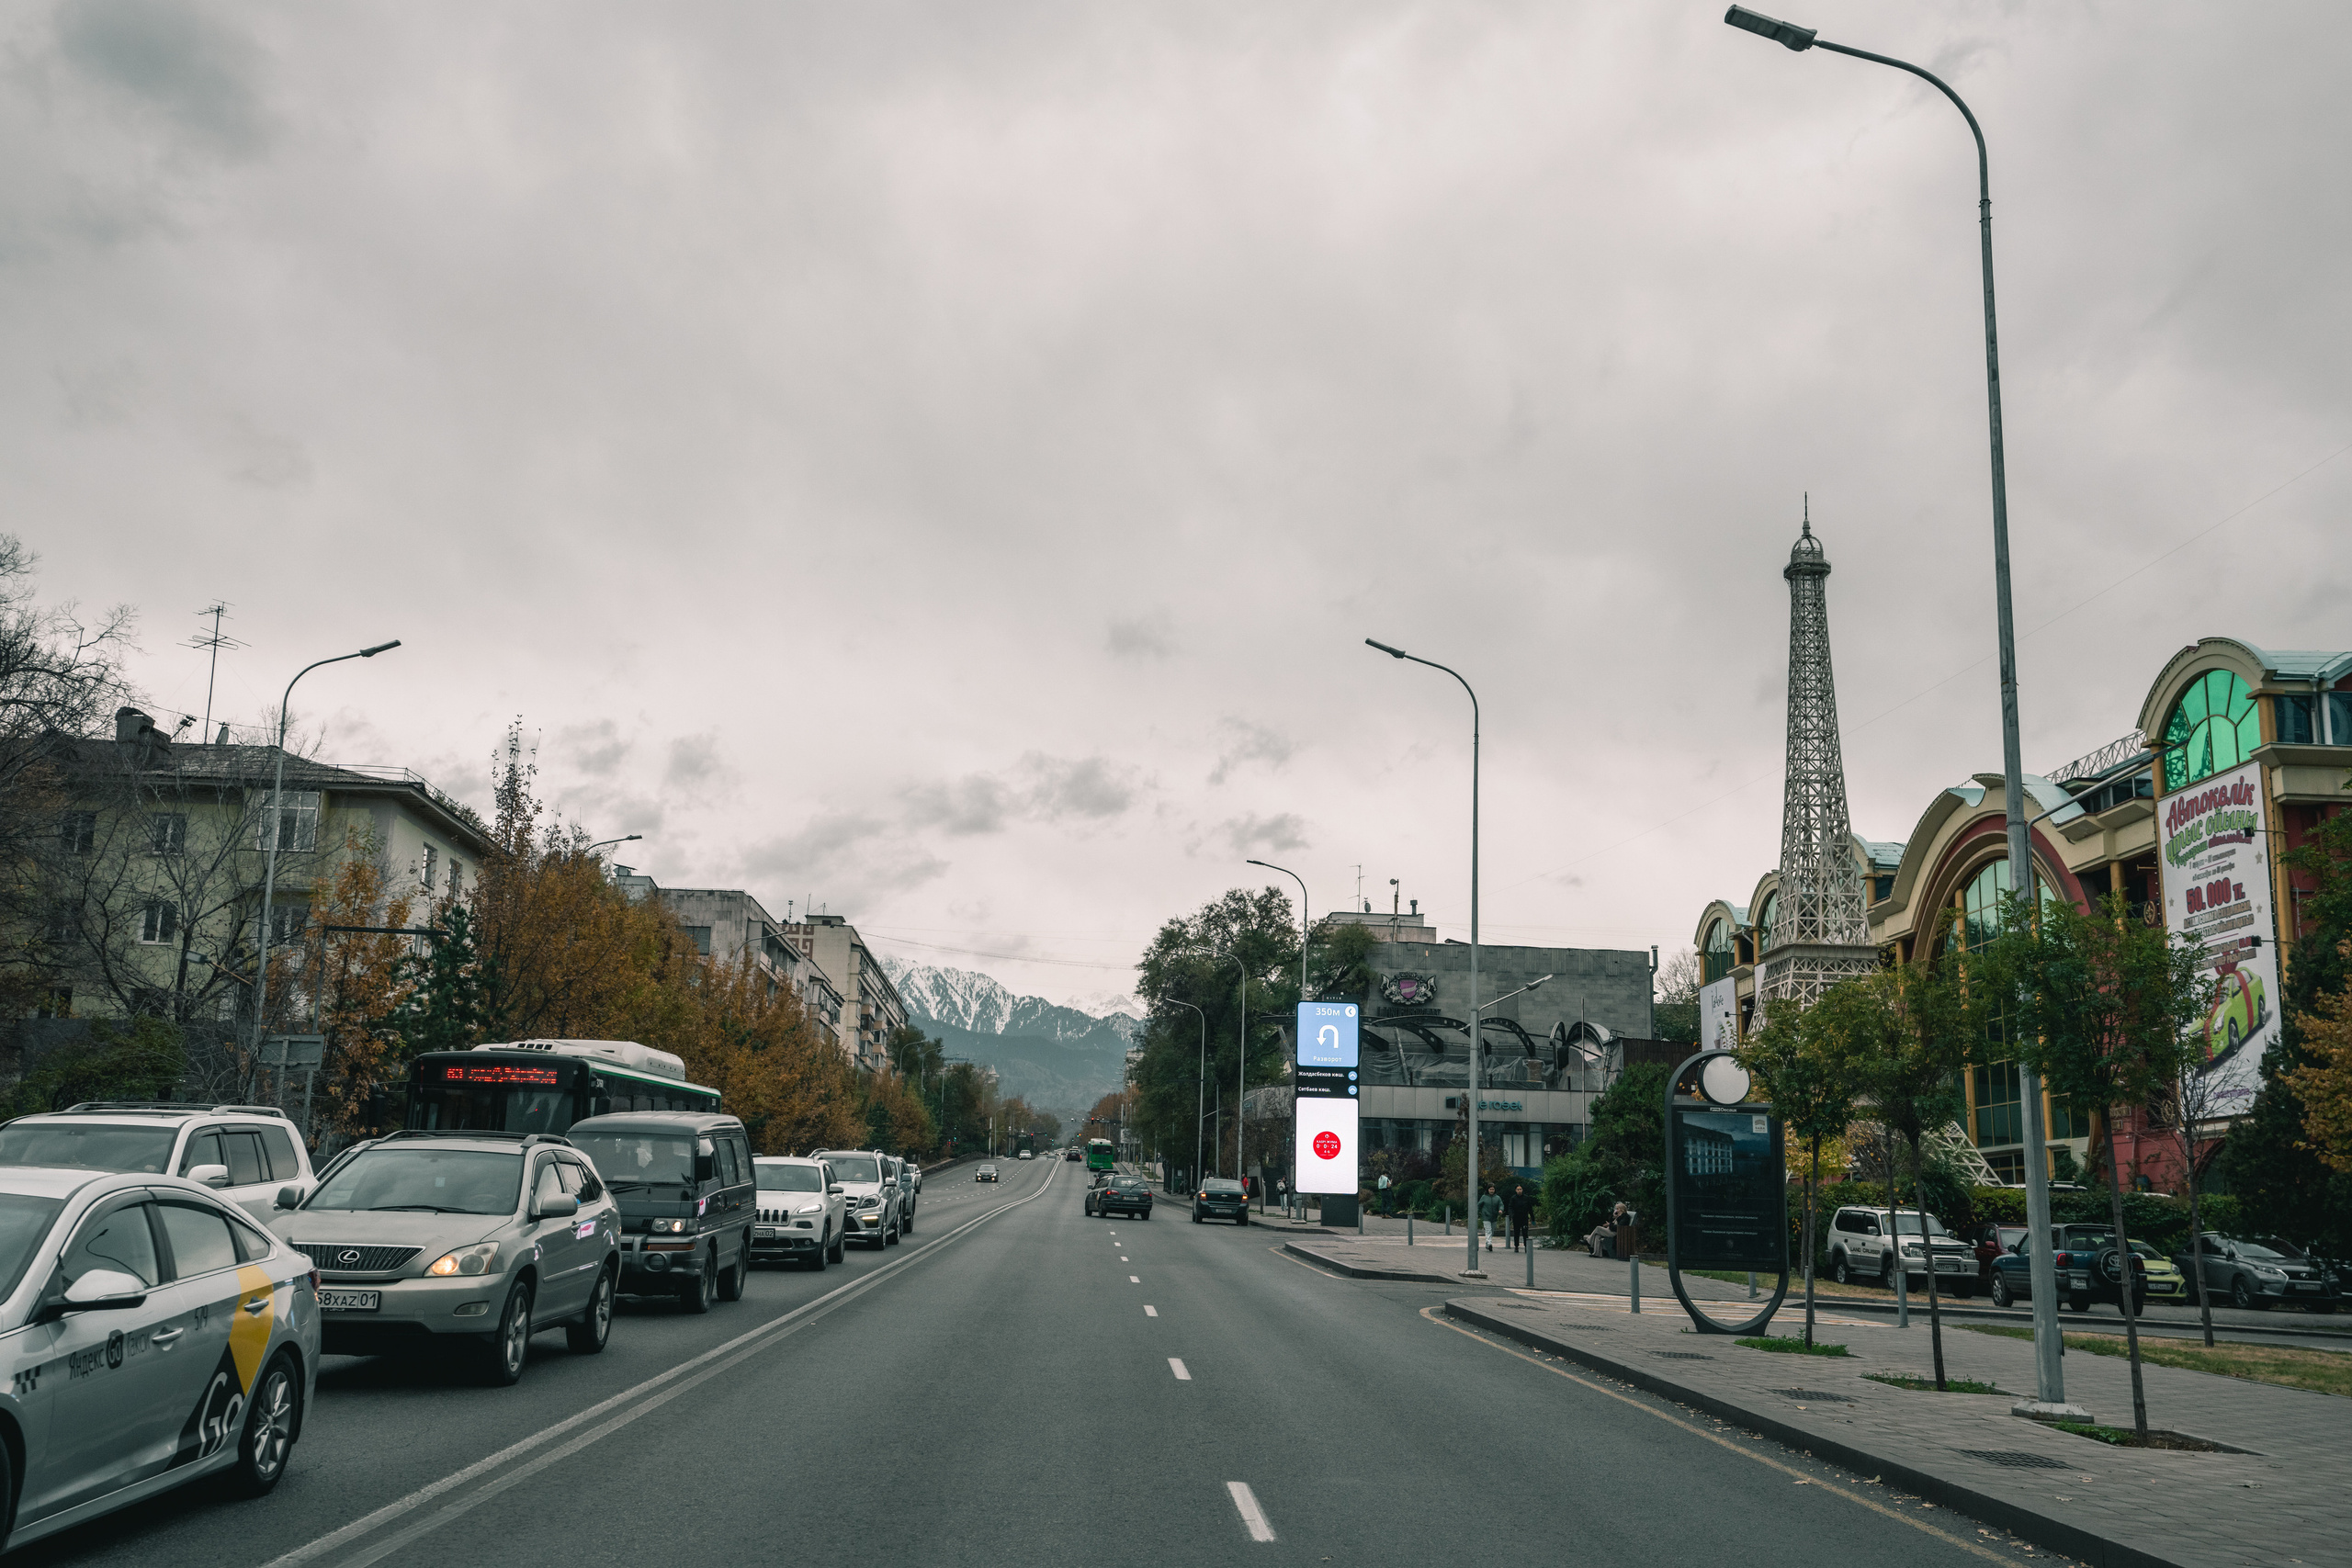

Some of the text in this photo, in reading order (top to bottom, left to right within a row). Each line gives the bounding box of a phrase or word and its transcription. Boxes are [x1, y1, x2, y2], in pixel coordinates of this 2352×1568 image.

[1489, 1100, 1522, 1111] roset
[69, 1348, 104, 1380] Яндекс
[127, 1332, 152, 1358] Такси
